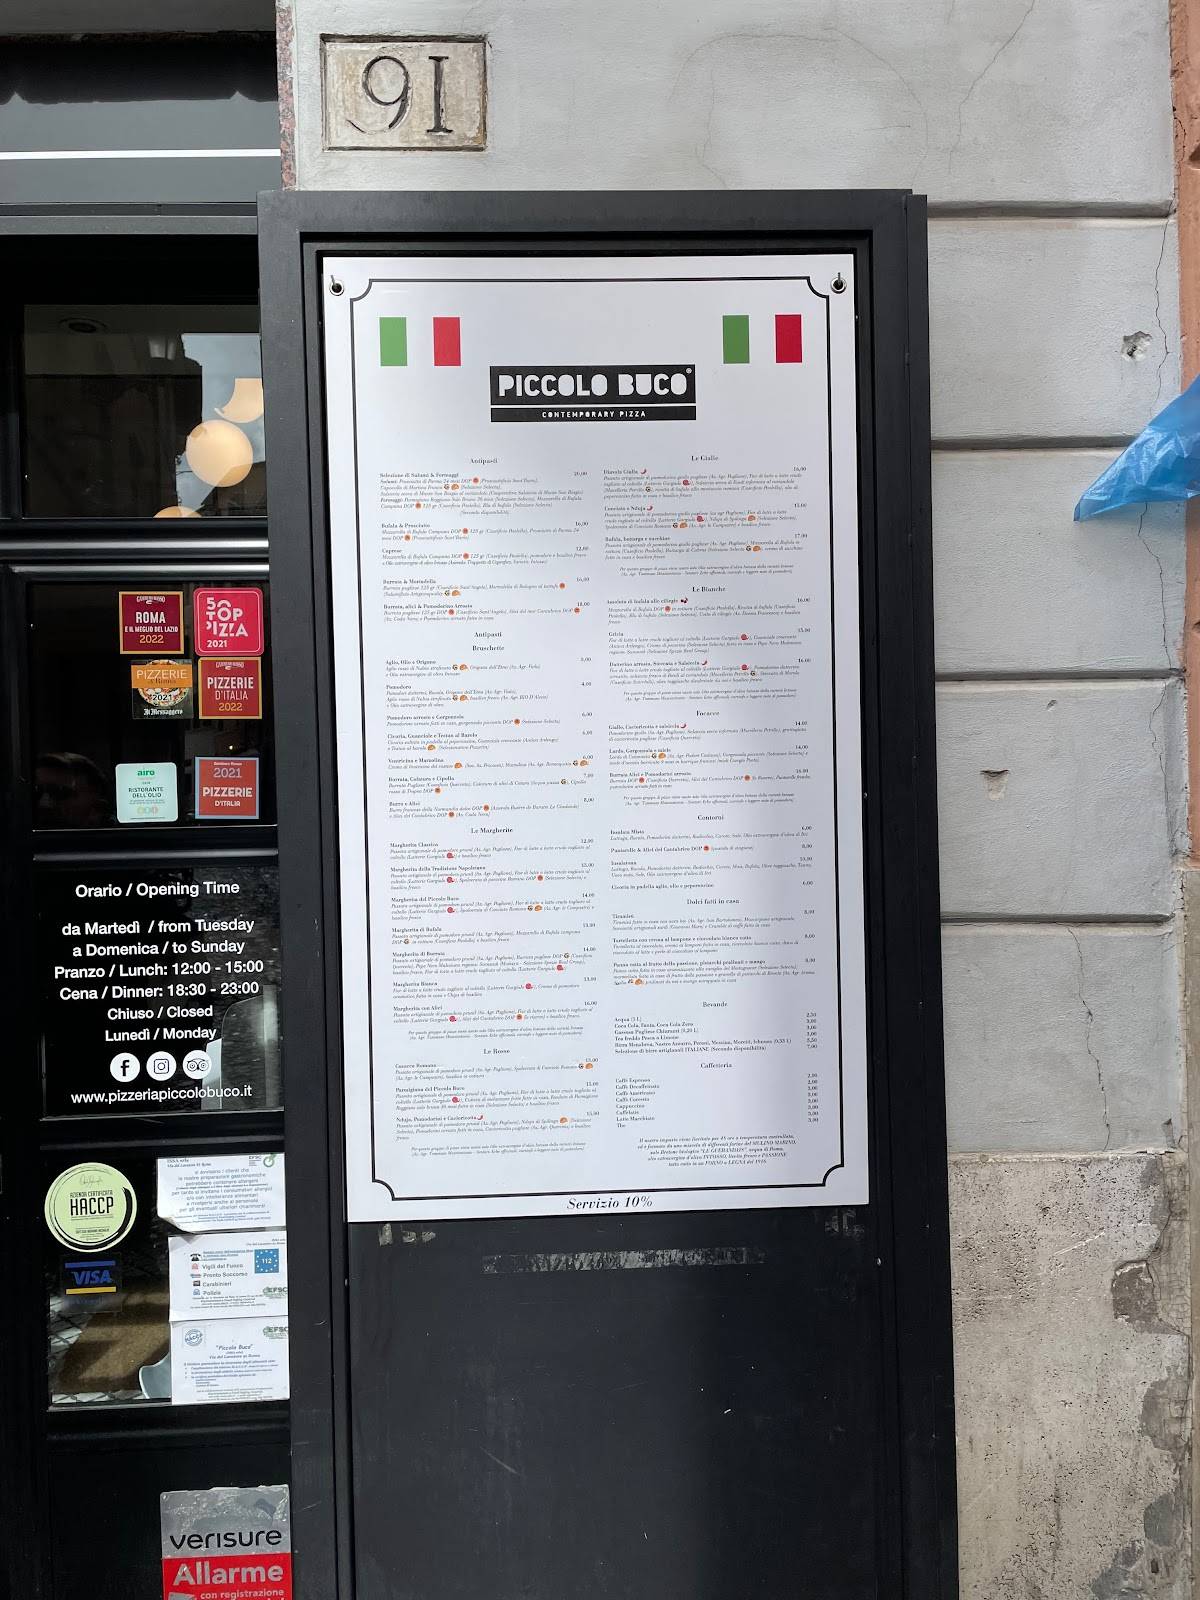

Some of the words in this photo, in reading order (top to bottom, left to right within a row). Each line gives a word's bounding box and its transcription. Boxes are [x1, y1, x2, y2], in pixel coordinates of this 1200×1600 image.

[346, 56, 453, 134] 91
[499, 374, 607, 396] PICCOLO
[136, 612, 166, 623] ROMA
[206, 608, 243, 621] TOP
[140, 635, 164, 643] 2022
[137, 670, 188, 679] PIZZERIE
[208, 677, 253, 688] PIZZERIE
[216, 691, 248, 700] D'ITALIA
[219, 703, 242, 711] 2022
[214, 768, 242, 778] 2021
[203, 787, 252, 797] PIZZERIE
[76, 884, 122, 897] Orario
[136, 882, 199, 898] Opening
[204, 881, 240, 894] Time
[62, 923, 81, 935] da
[85, 921, 140, 934] Martedì
[158, 921, 191, 932] from
[195, 919, 254, 933] Tuesday
[86, 943, 159, 956] Domenica
[172, 942, 187, 953] to
[191, 941, 245, 955] Sunday
[55, 966, 105, 979] Pranzo
[120, 964, 168, 977] Lunch:
[172, 962, 210, 975] 12:00
[226, 960, 263, 973] 15:00
[60, 987, 98, 1000] Cena
[112, 986, 163, 998] Dinner:
[167, 984, 206, 996] 18:30
[221, 982, 259, 995] 23:00
[107, 1008, 154, 1020] Chiuso
[167, 1005, 213, 1018] Closed
[105, 1029, 150, 1041] Lunedì
[163, 1028, 216, 1041] Monday
[71, 1085, 252, 1104] www.pizzeriapiccolobuco.it
[70, 1197, 113, 1216] HACCP
[566, 1197, 619, 1211] Servizio
[623, 1195, 653, 1209] 10%
[71, 1270, 112, 1286] VISA
[170, 1530, 282, 1549] verisure
[173, 1561, 283, 1585] Allarme
[220, 1588, 284, 1600] registrazione
